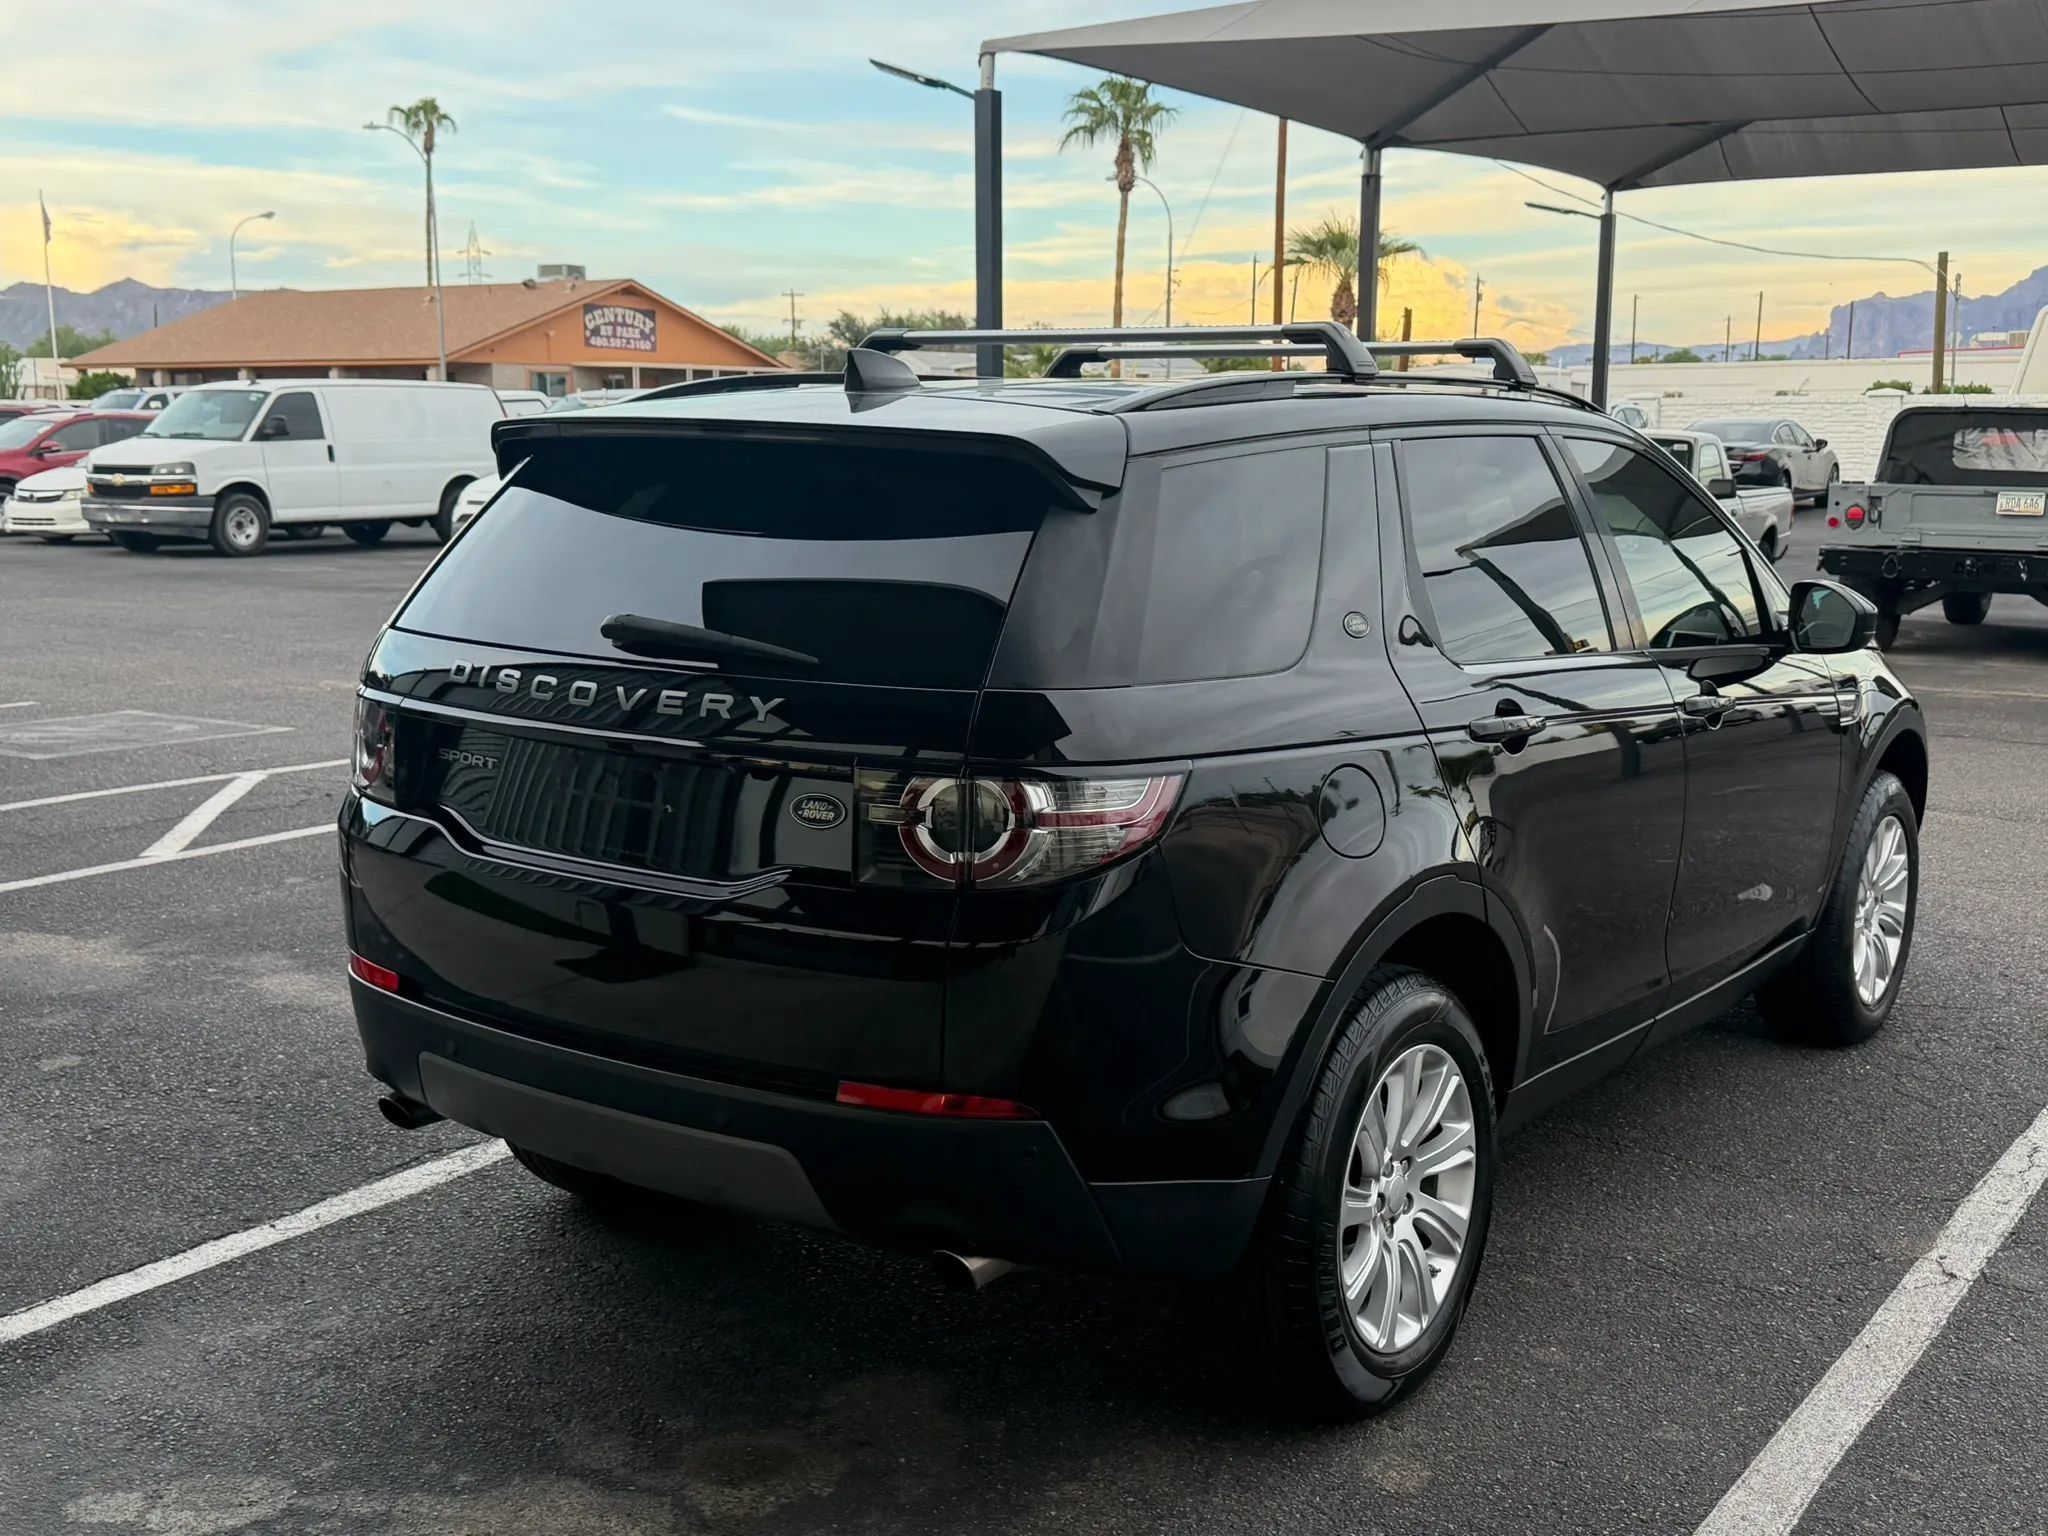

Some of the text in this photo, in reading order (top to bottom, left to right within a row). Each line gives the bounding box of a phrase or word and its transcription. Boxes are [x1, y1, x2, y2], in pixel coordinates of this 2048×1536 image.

[584, 307, 654, 335] CENTURY
[600, 325, 641, 339] RV PARK
[450, 659, 786, 722] DISCOVERY
[438, 747, 499, 770] SPORT
[801, 799, 828, 811] LAND
[802, 808, 835, 821] ROVER
